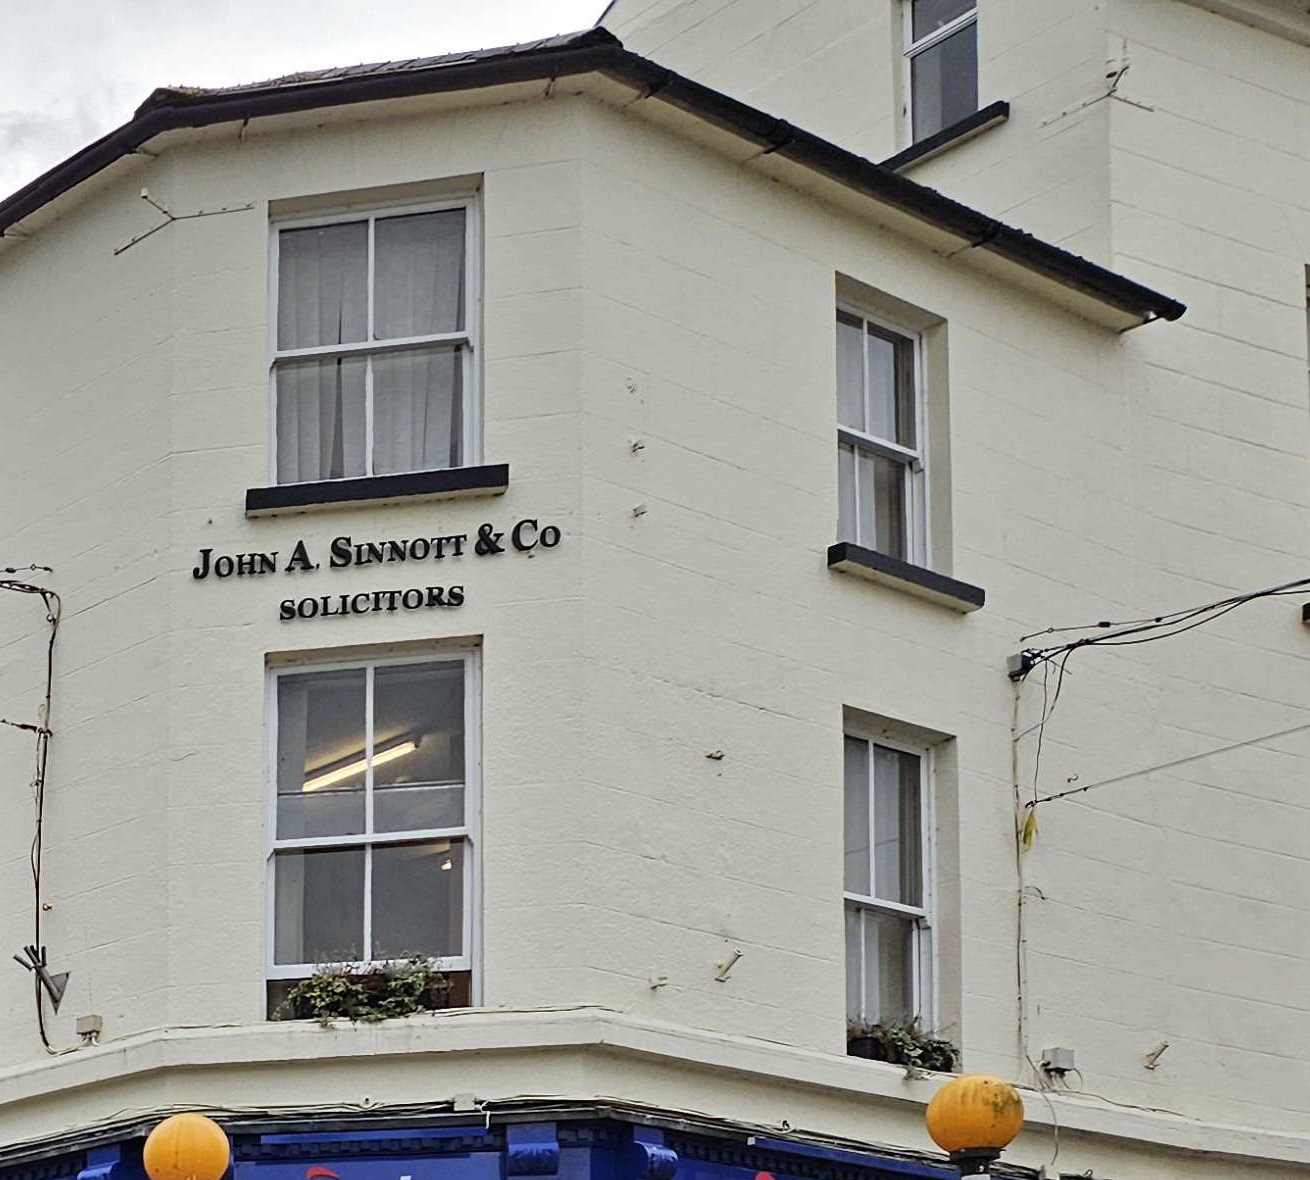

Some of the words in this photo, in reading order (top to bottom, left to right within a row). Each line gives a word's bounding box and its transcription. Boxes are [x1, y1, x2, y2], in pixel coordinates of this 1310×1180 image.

[285, 540, 321, 572] A.
[474, 522, 505, 557] &
[279, 585, 465, 621] SOLICITORS
